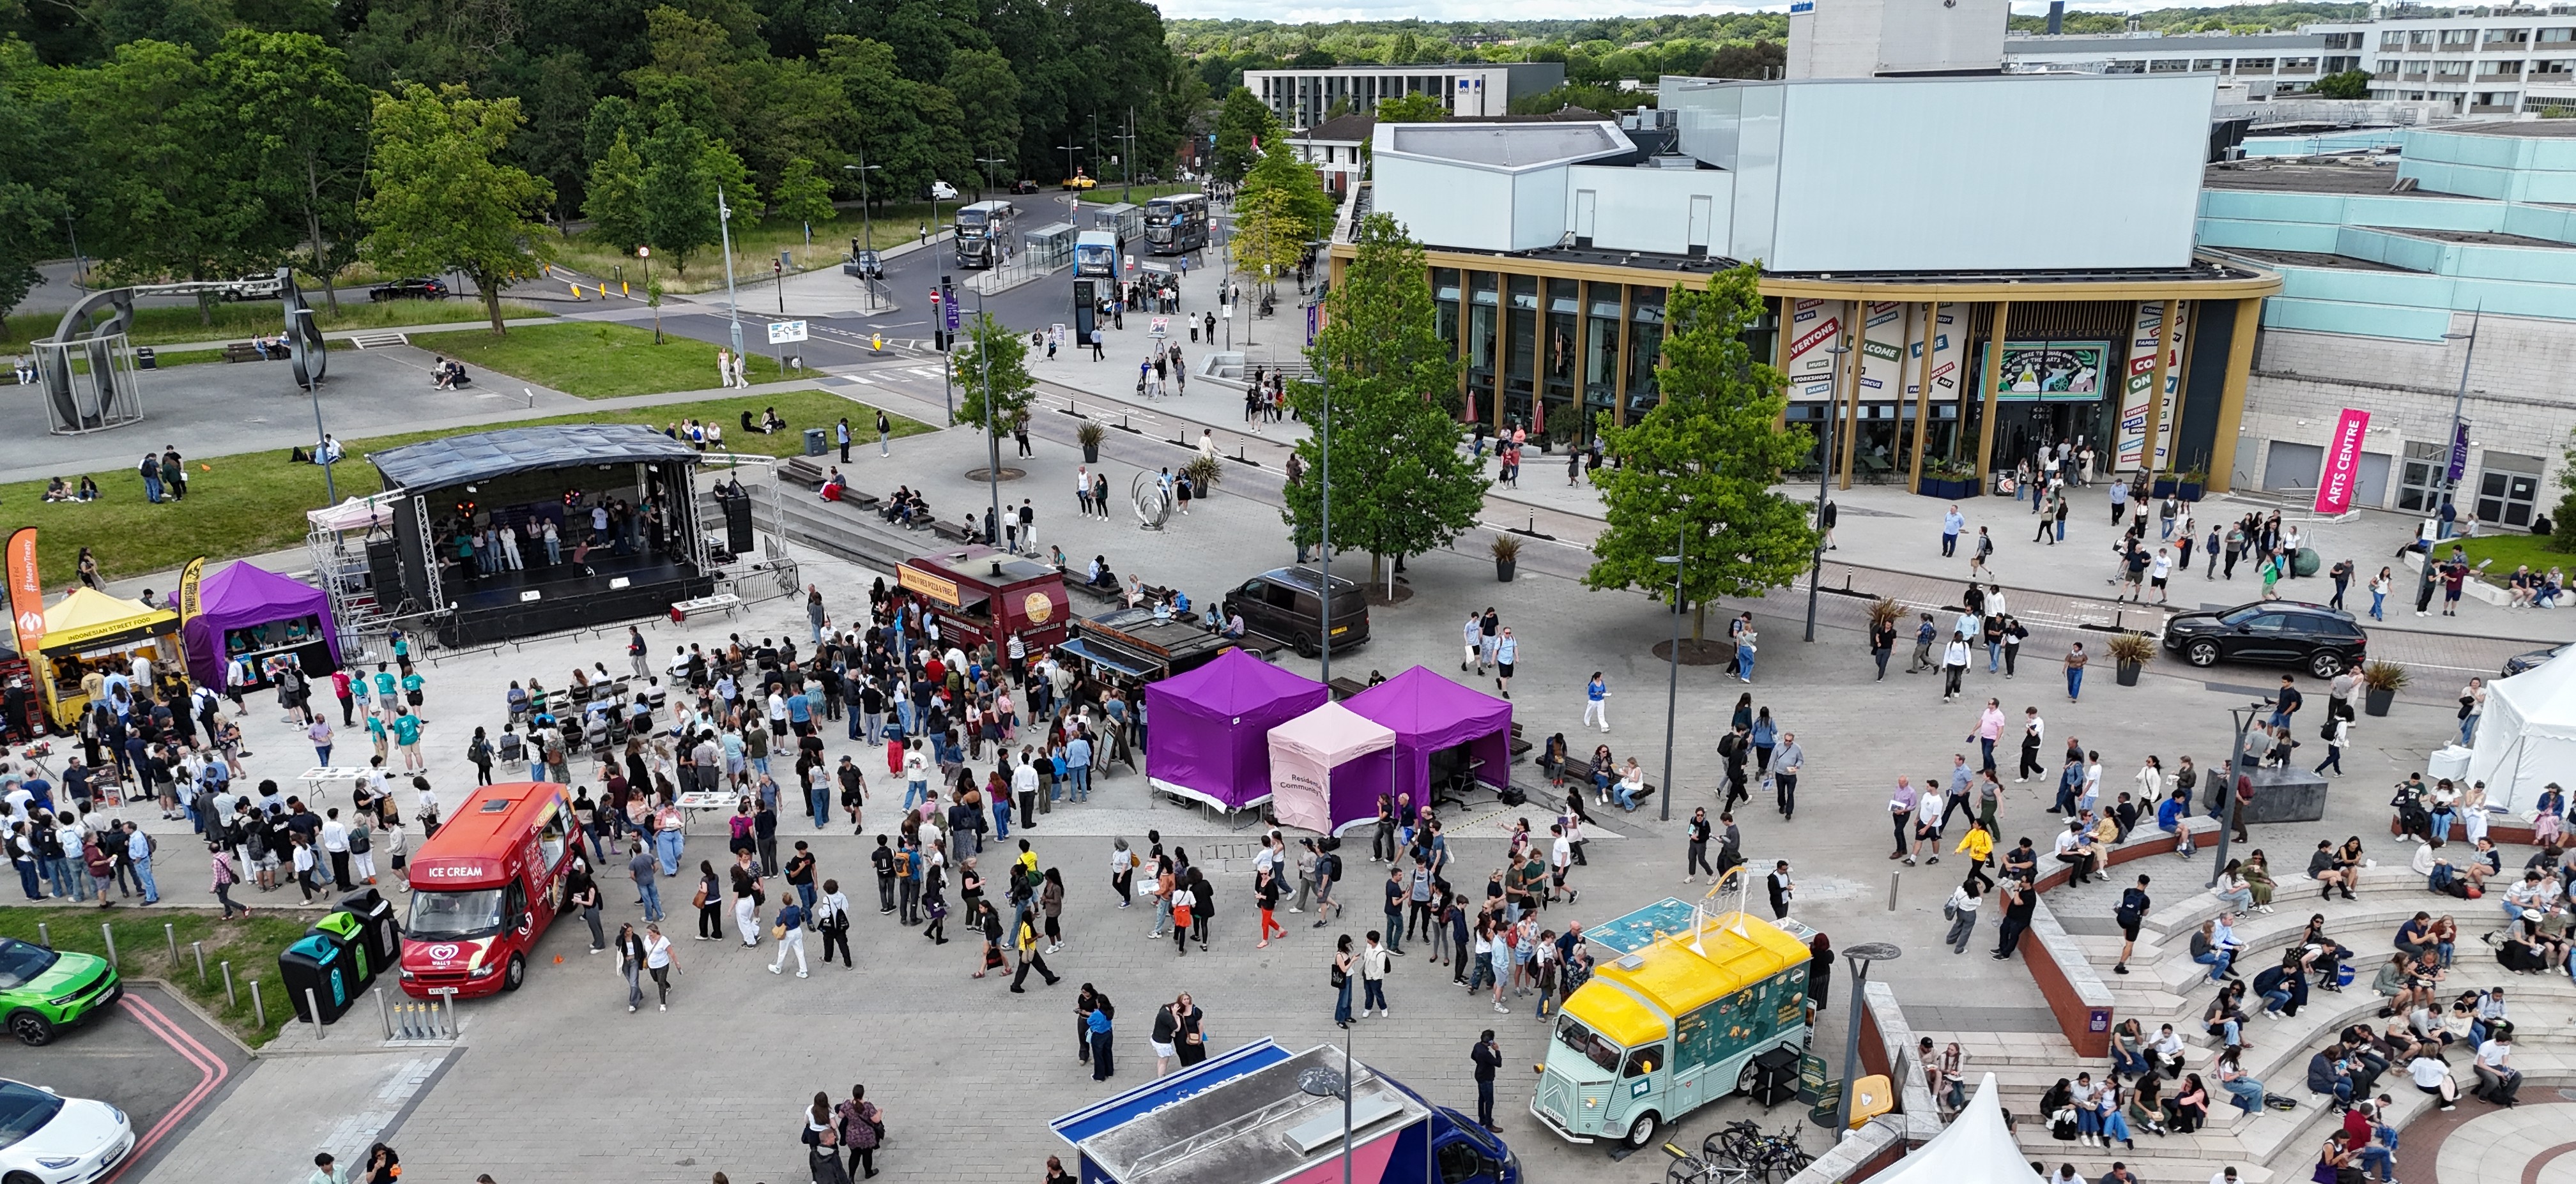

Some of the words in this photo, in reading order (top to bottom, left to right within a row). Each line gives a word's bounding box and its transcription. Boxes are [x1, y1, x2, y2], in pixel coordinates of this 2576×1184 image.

[1796, 312, 1814, 321] PLAYS
[1866, 312, 1896, 327] HIBITIONS
[1790, 322, 1835, 357] VERYONE
[1916, 338, 1944, 354] HRE
[1931, 363, 1953, 377] NCERTS
[1793, 374, 1831, 383] WORKSHOPS
[1860, 379, 1881, 388] CIRCUS
[2132, 374, 2151, 389] ON
[1807, 384, 1828, 393] DANCE
[2123, 418, 2142, 428] PLAYS
[2327, 472, 2347, 505] ARTS
[2337, 420, 2360, 471] CENTRE
[68, 628, 108, 641] INDONESIAN
[109, 621, 132, 633] STREET
[134, 616, 151, 625] FOOD
[429, 868, 444, 877] ICE
[447, 867, 482, 877] CREAM
